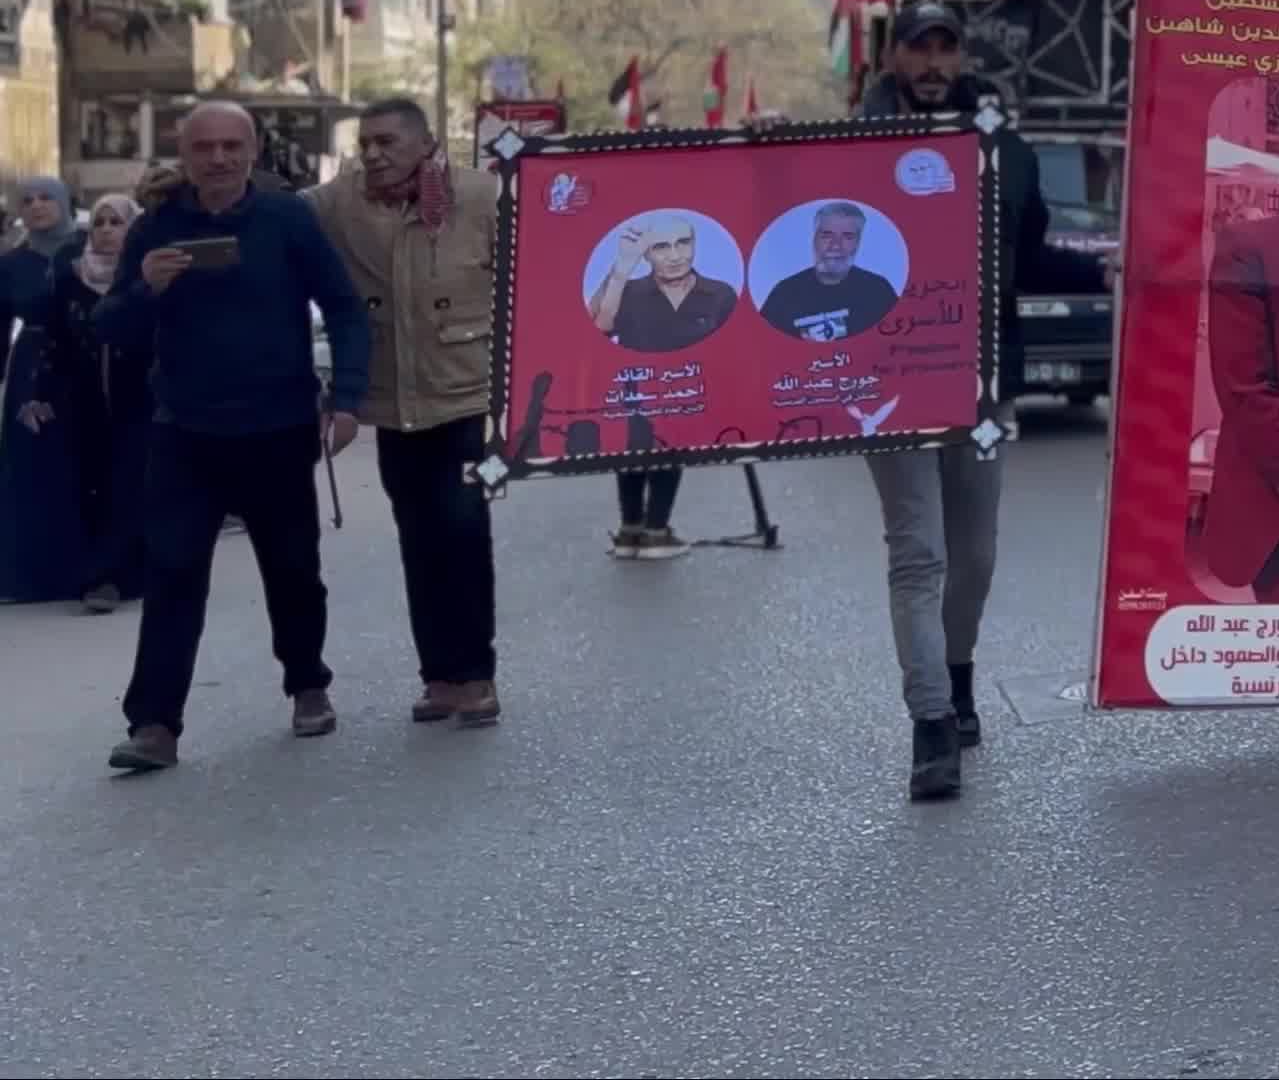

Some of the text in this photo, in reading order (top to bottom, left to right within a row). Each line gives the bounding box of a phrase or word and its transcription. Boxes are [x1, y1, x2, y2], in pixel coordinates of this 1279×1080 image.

[1145, 16, 1224, 35] شاهين
[1181, 50, 1249, 68] عيسى
[773, 374, 799, 390] الله
[1186, 614, 1216, 632] الله
[1221, 619, 1250, 637] عبد
[1160, 644, 1208, 671] داخل
